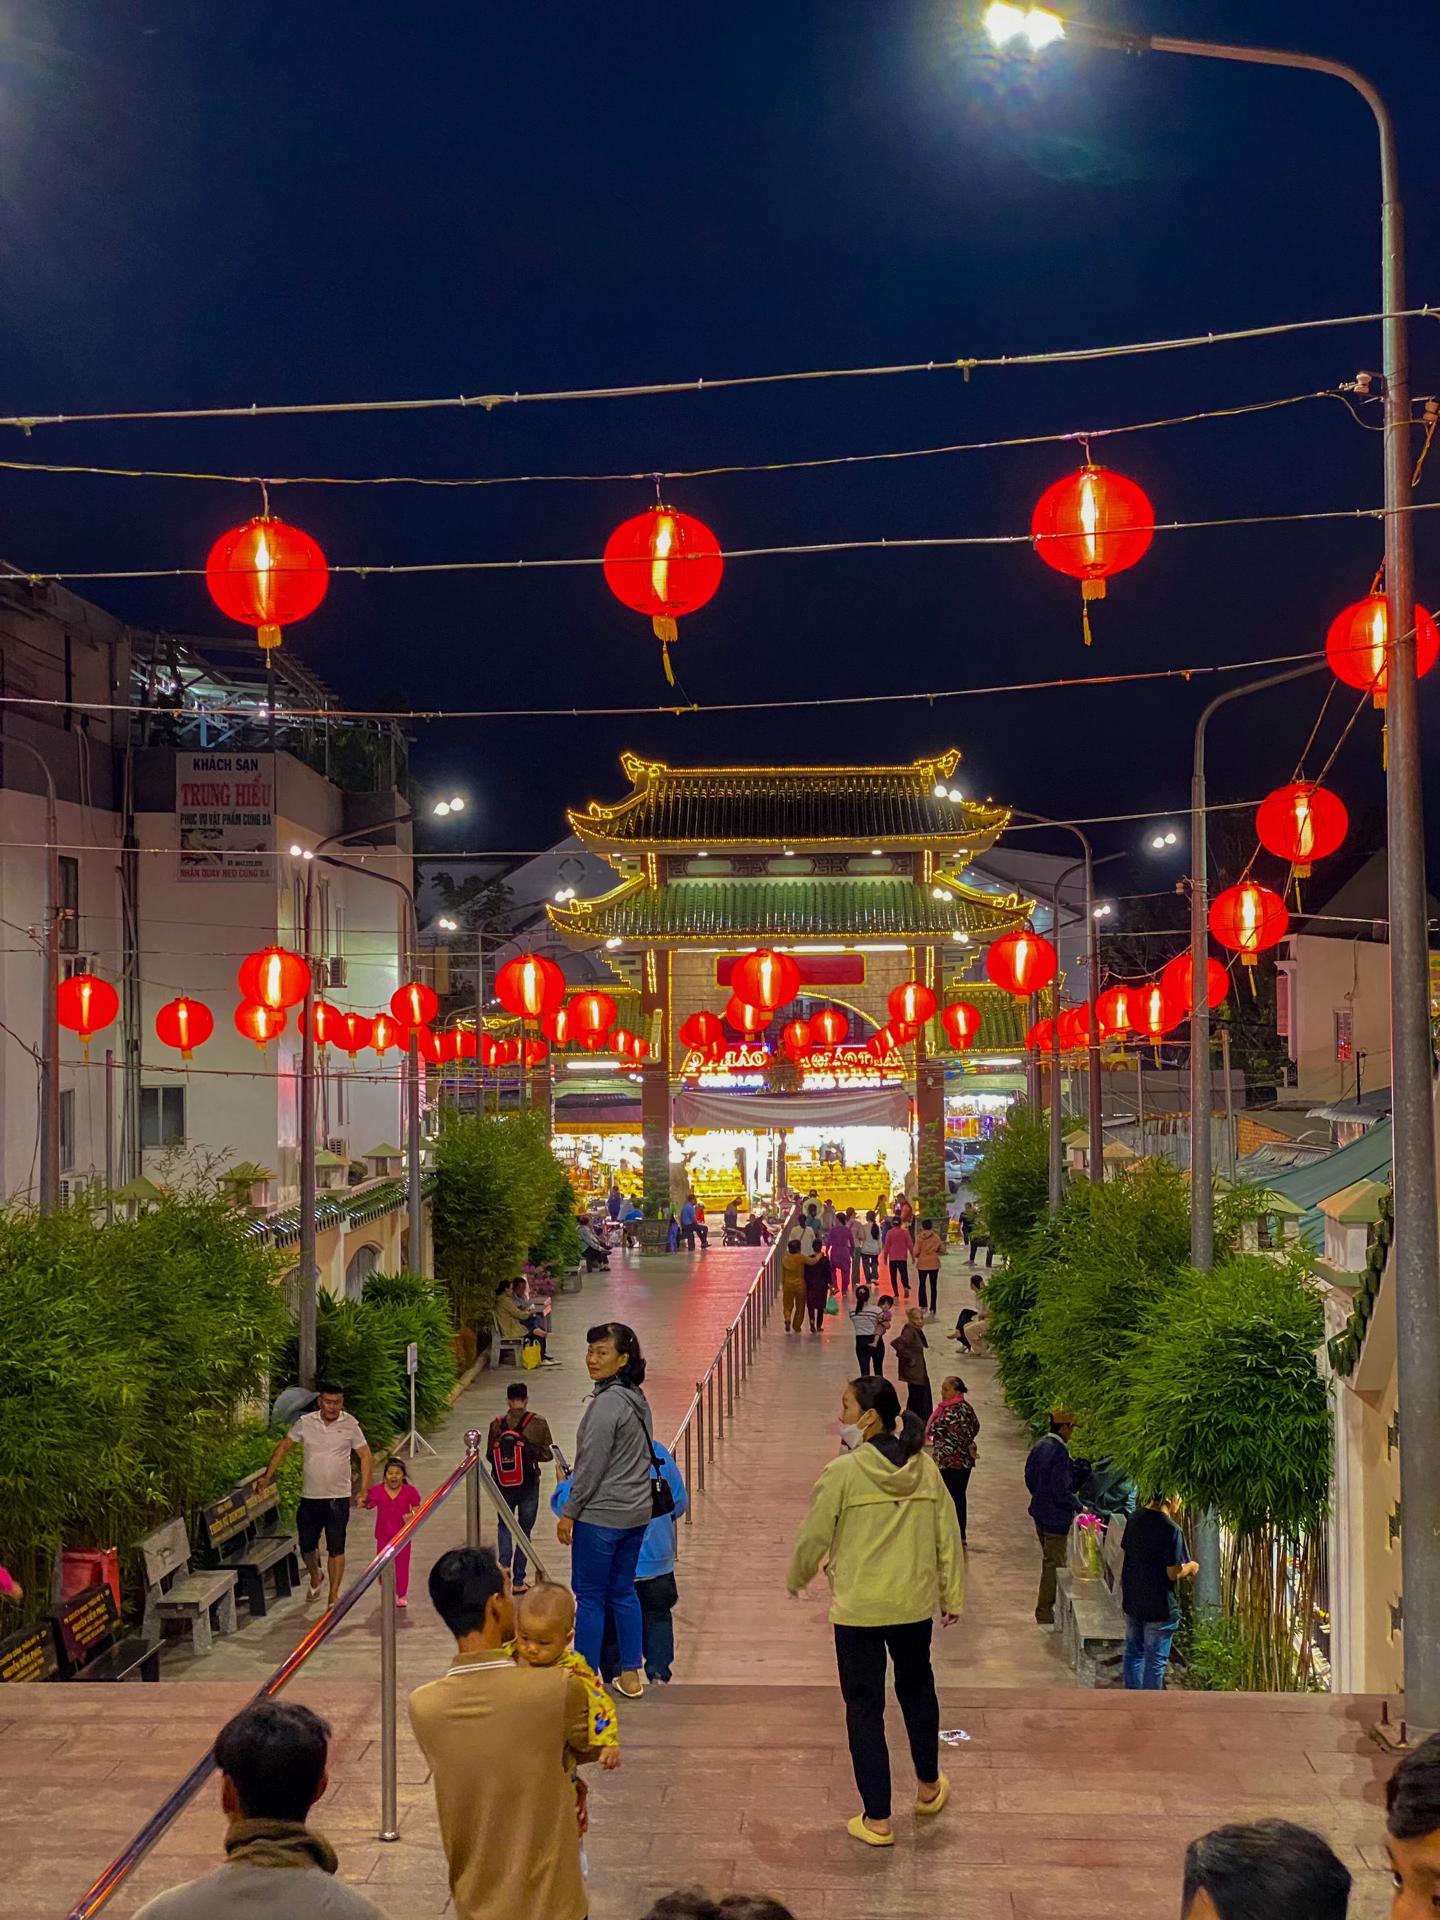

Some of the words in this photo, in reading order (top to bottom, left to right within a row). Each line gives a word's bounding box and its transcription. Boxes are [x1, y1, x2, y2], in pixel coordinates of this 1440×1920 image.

[193, 754, 232, 771] KHÁCH
[235, 758, 259, 773] SẠN
[181, 782, 231, 808] TRUNG
